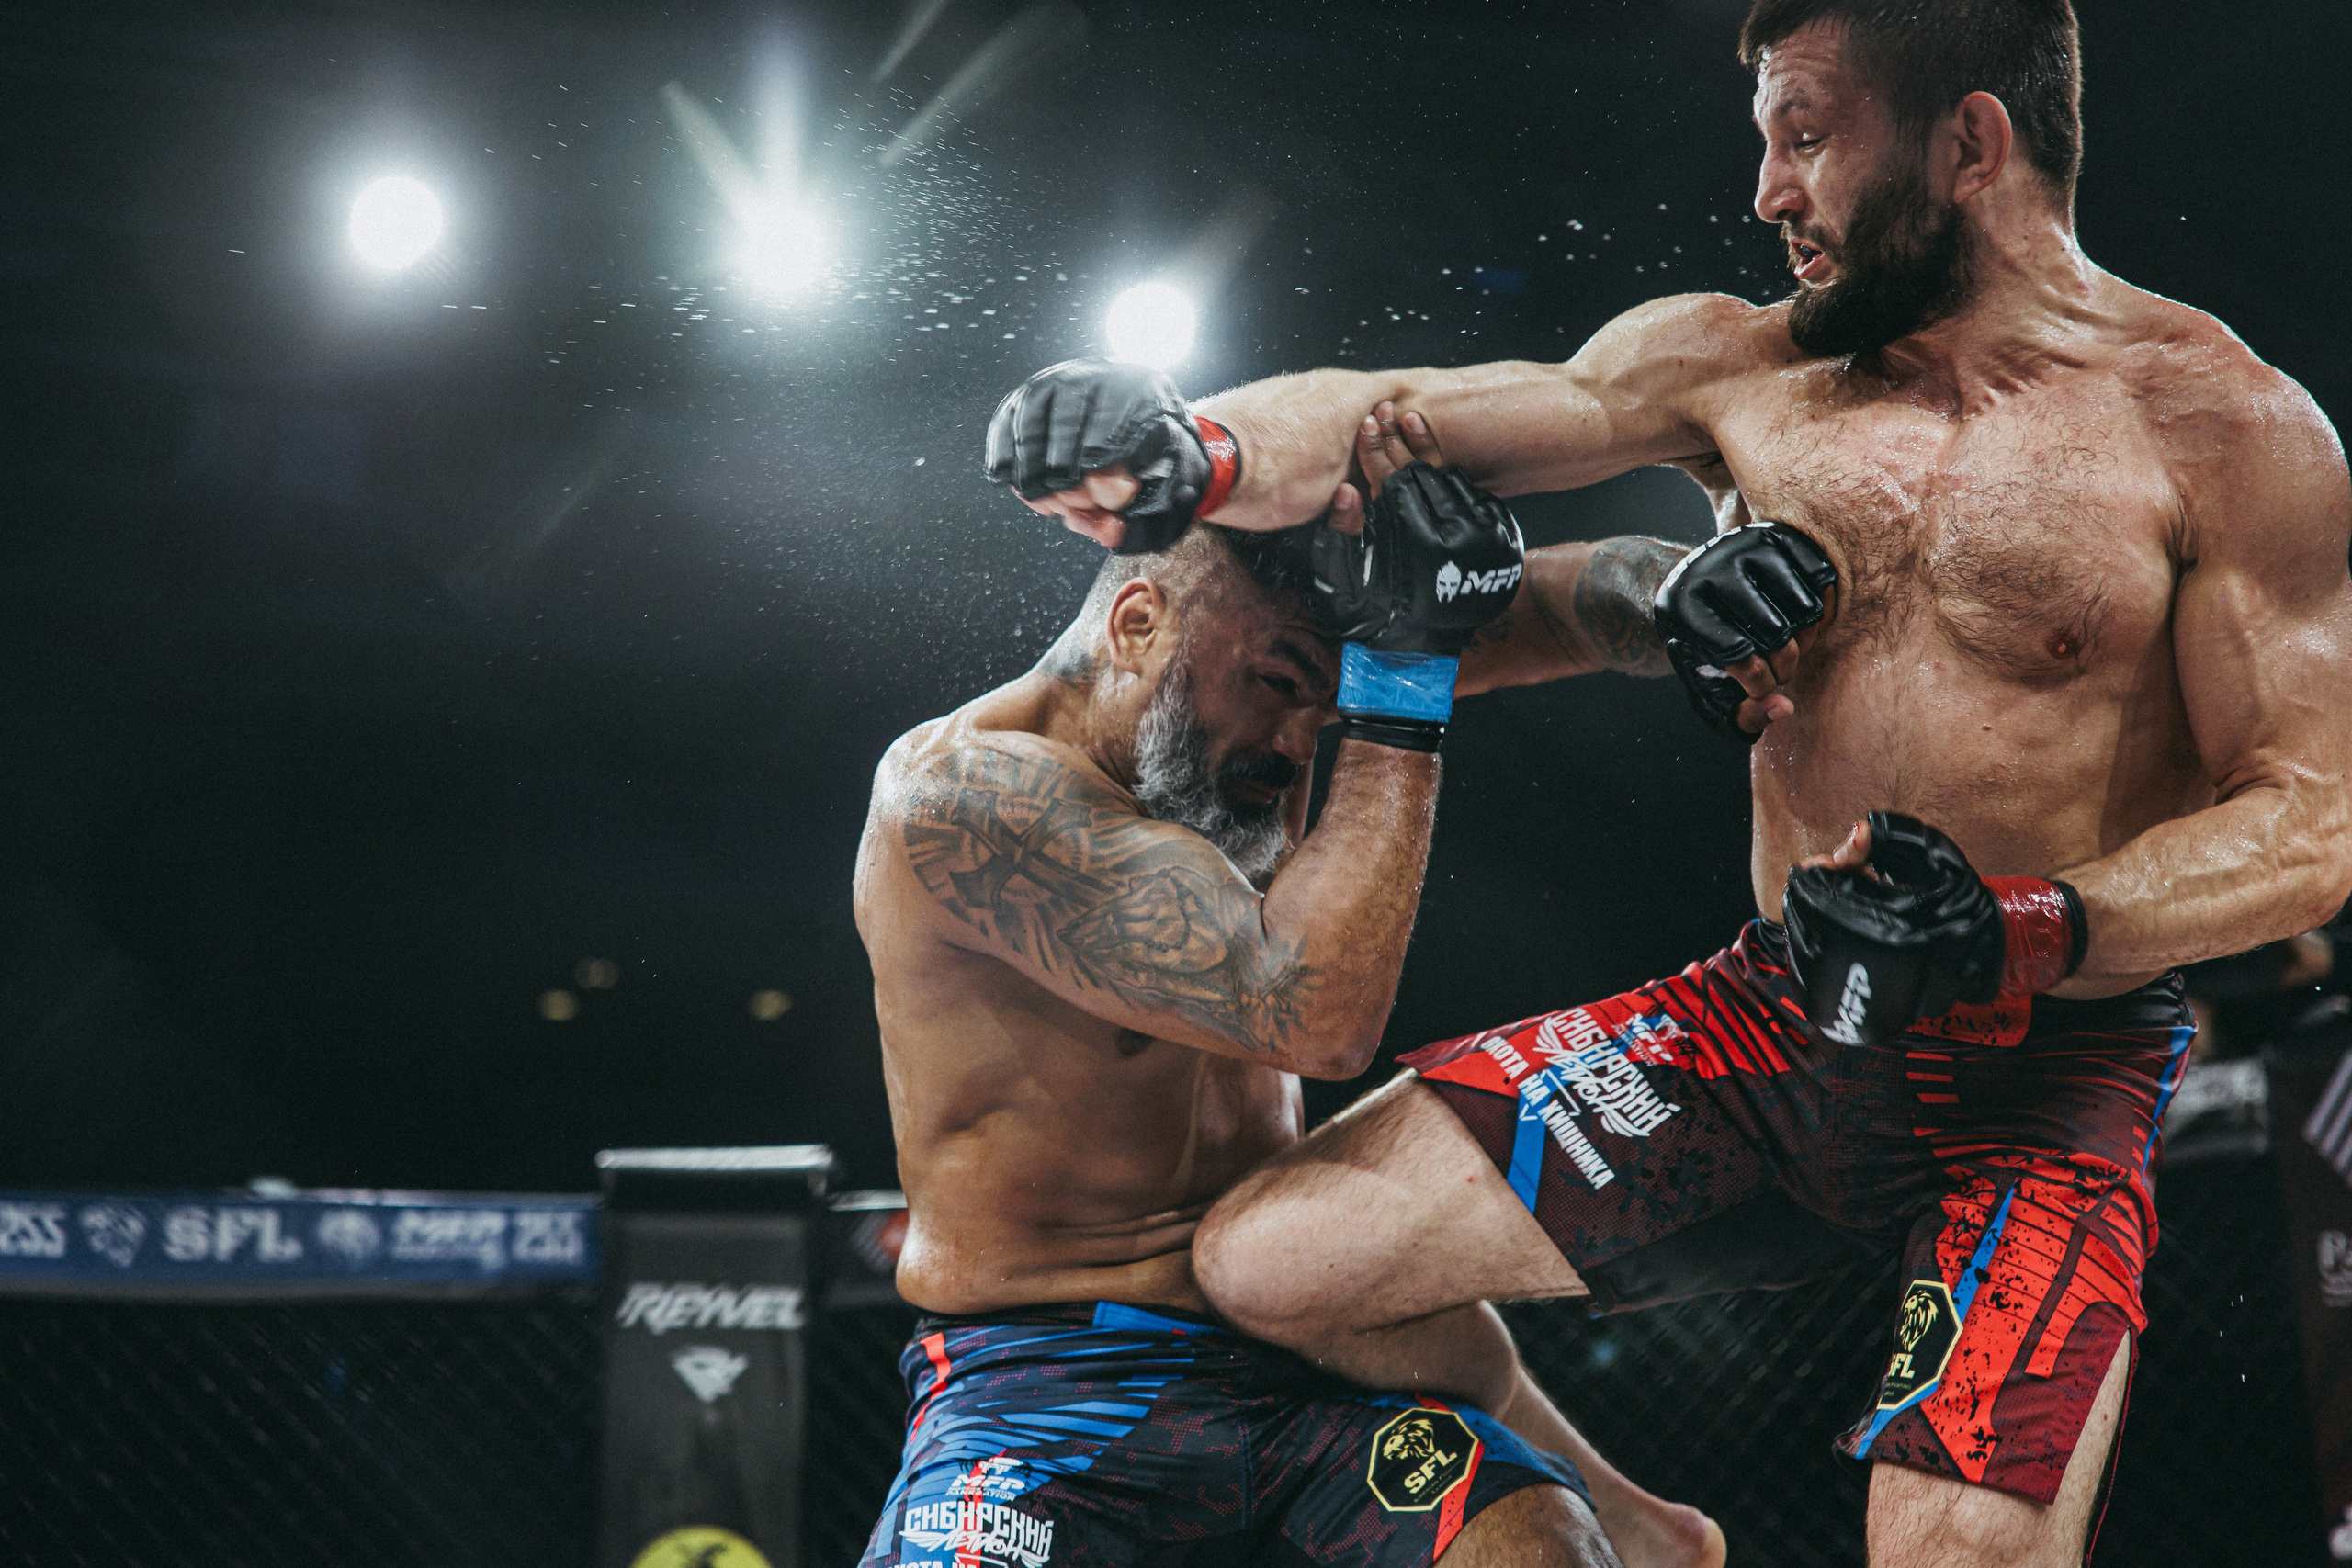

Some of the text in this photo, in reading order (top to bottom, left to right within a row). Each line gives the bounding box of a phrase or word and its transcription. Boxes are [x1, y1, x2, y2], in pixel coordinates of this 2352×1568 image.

[1481, 1035, 1615, 1190] ОХОТА НА ХИЩНИКА
[951, 1473, 1025, 1491] MFP
[1404, 1450, 1457, 1494] SFL
